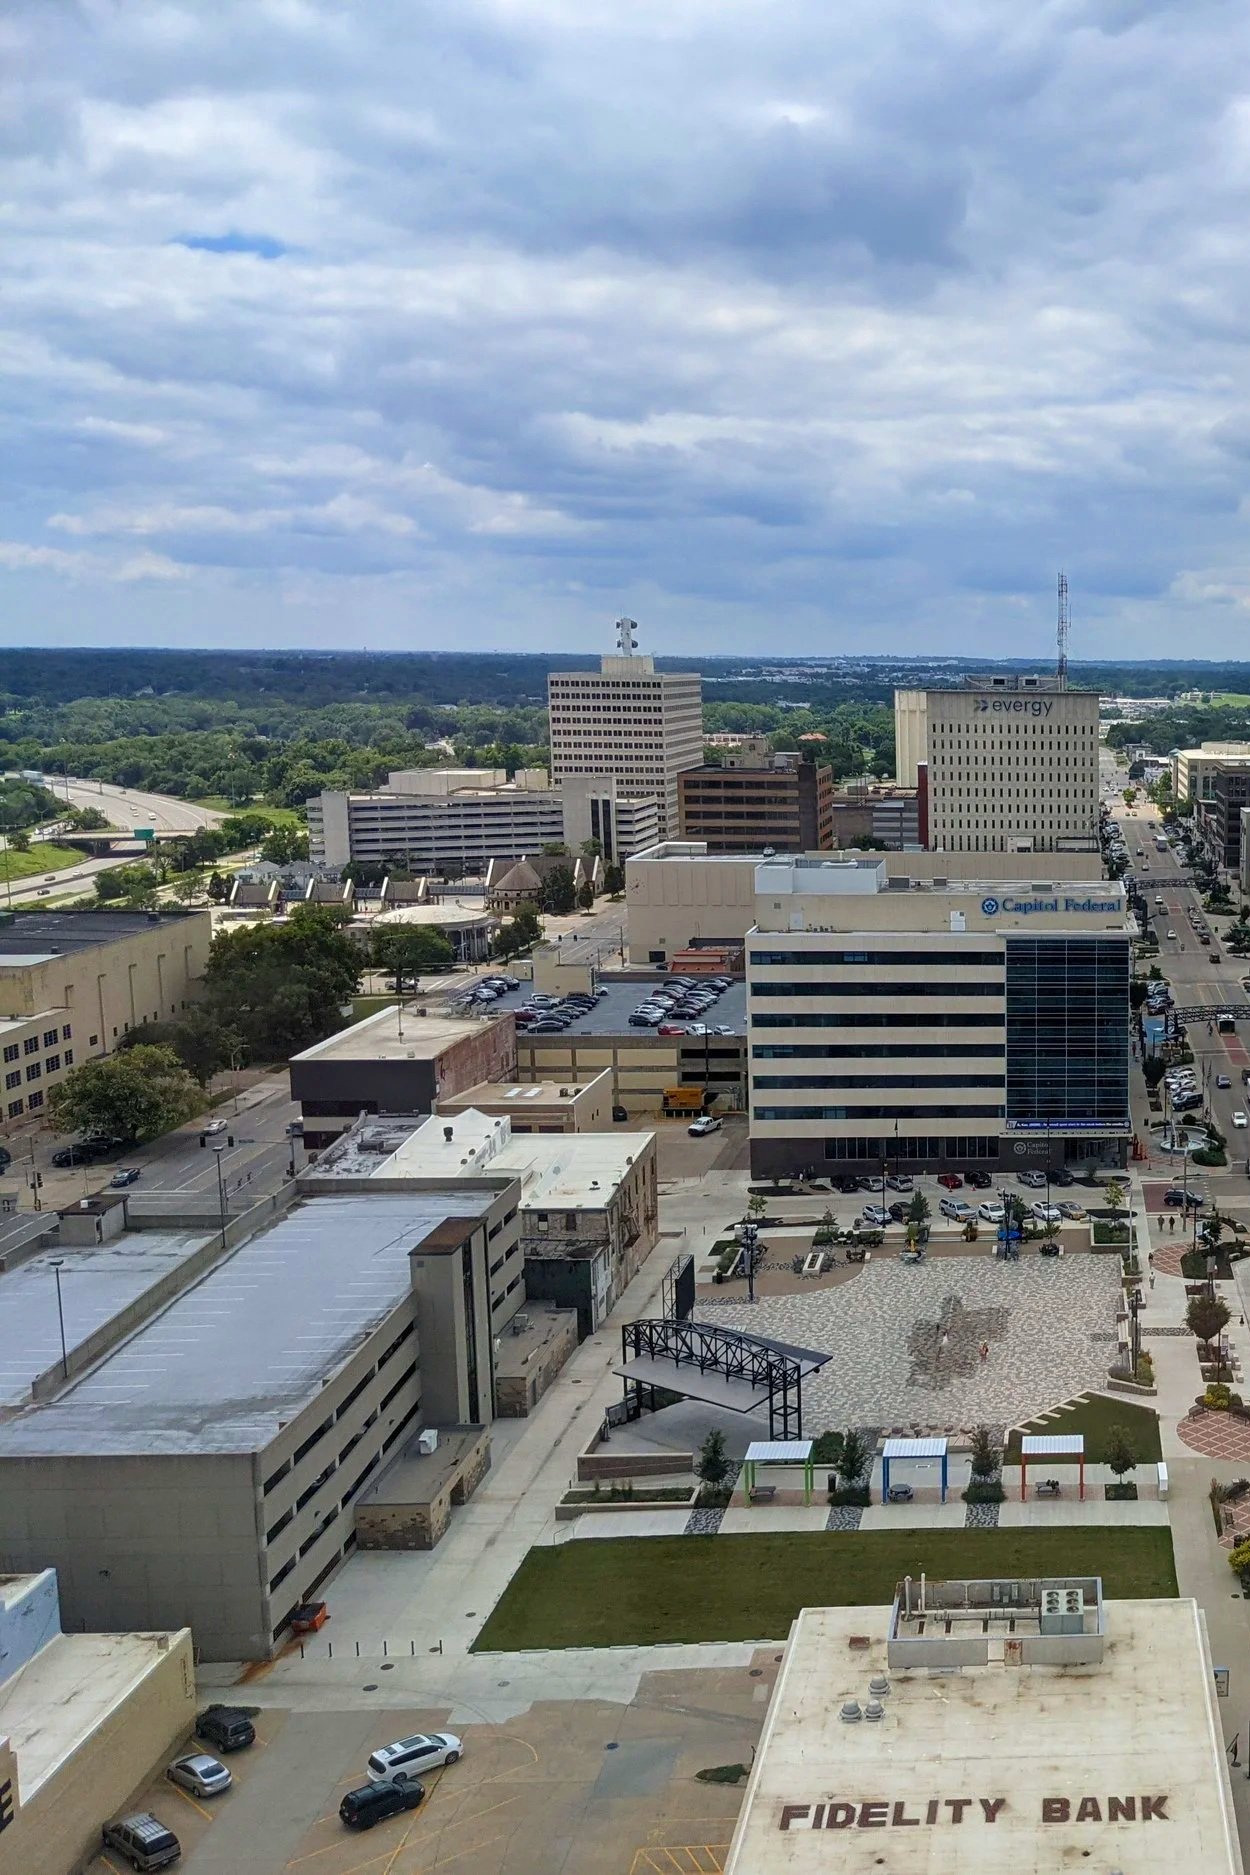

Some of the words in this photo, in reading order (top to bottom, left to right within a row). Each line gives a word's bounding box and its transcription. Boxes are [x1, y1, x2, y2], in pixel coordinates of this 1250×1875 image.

[992, 700, 1053, 717] evergy
[1002, 898, 1058, 914] Capitol
[1064, 898, 1121, 912] Federal
[1027, 1141, 1050, 1149] Capito
[779, 1798, 1006, 1830] FIDELITY
[1042, 1796, 1169, 1823] BANK
